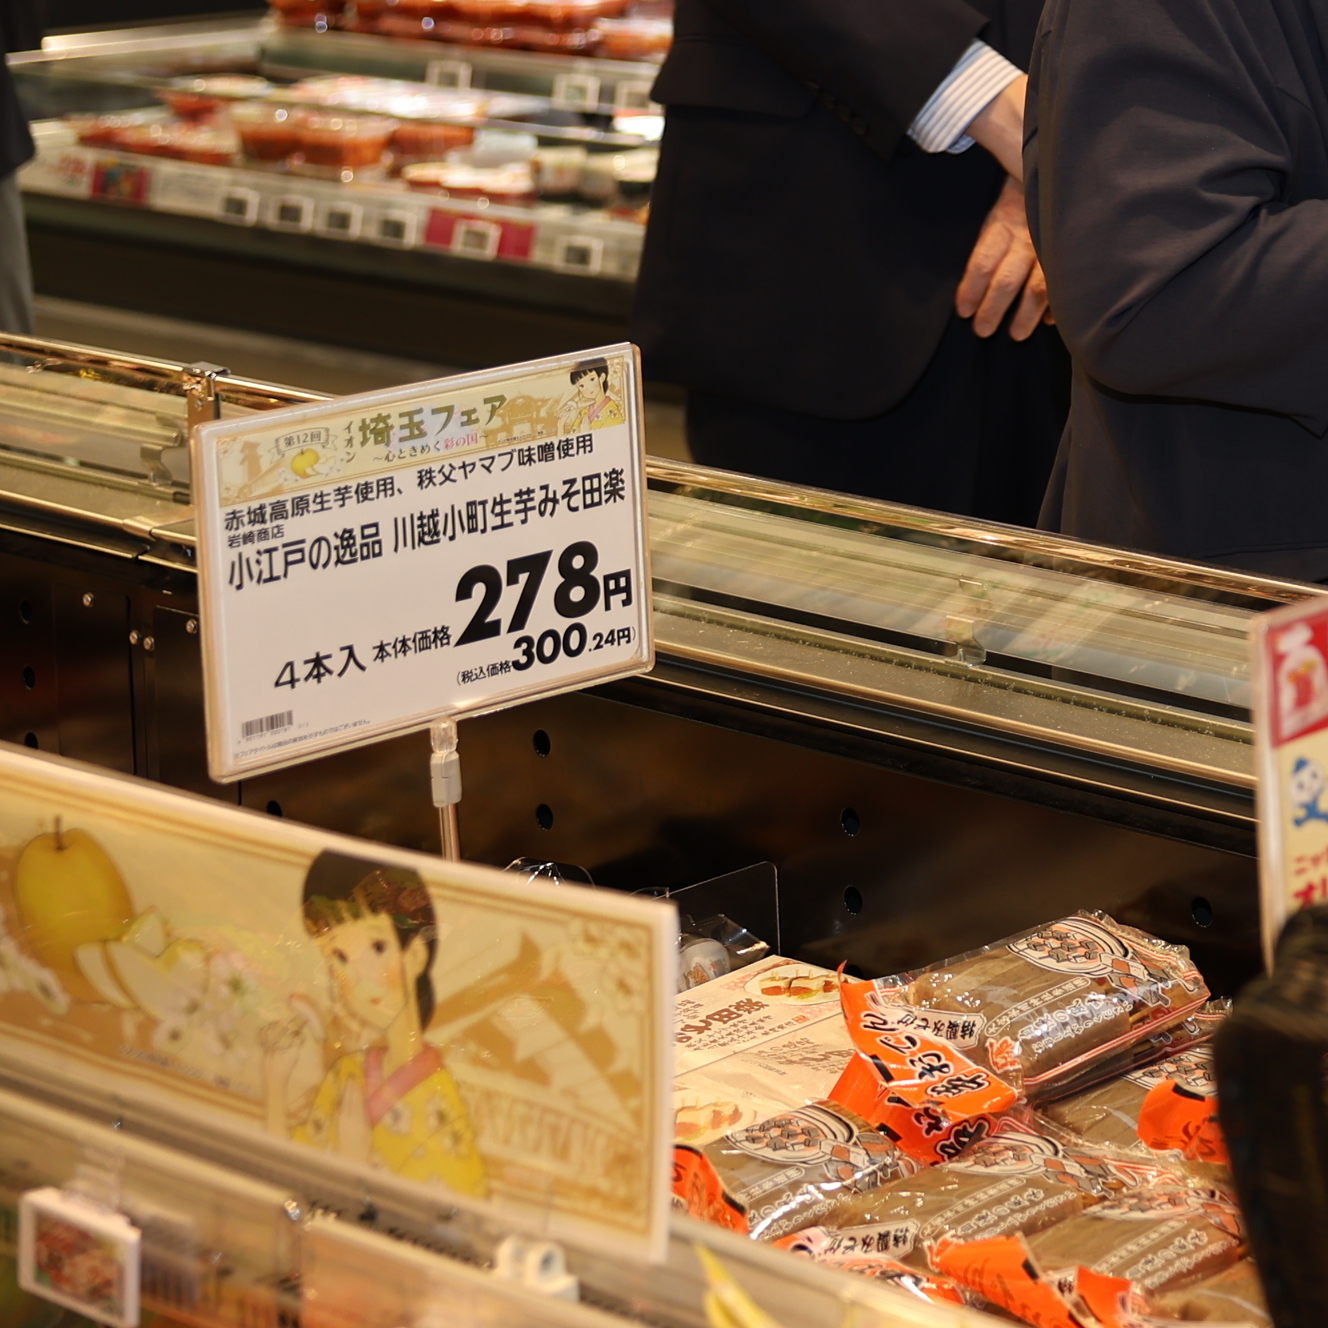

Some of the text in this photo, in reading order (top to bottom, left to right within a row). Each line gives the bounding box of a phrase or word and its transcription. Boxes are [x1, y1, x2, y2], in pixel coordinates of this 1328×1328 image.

[282, 429, 324, 448] 第12回
[342, 421, 357, 464] イオン
[358, 393, 509, 448] 埼玉フェア
[227, 524, 286, 550] 岩崎商店
[228, 467, 626, 591] 小江戸の逸品 川越小町生芋みそ田楽
[273, 642, 366, 691] 4本入
